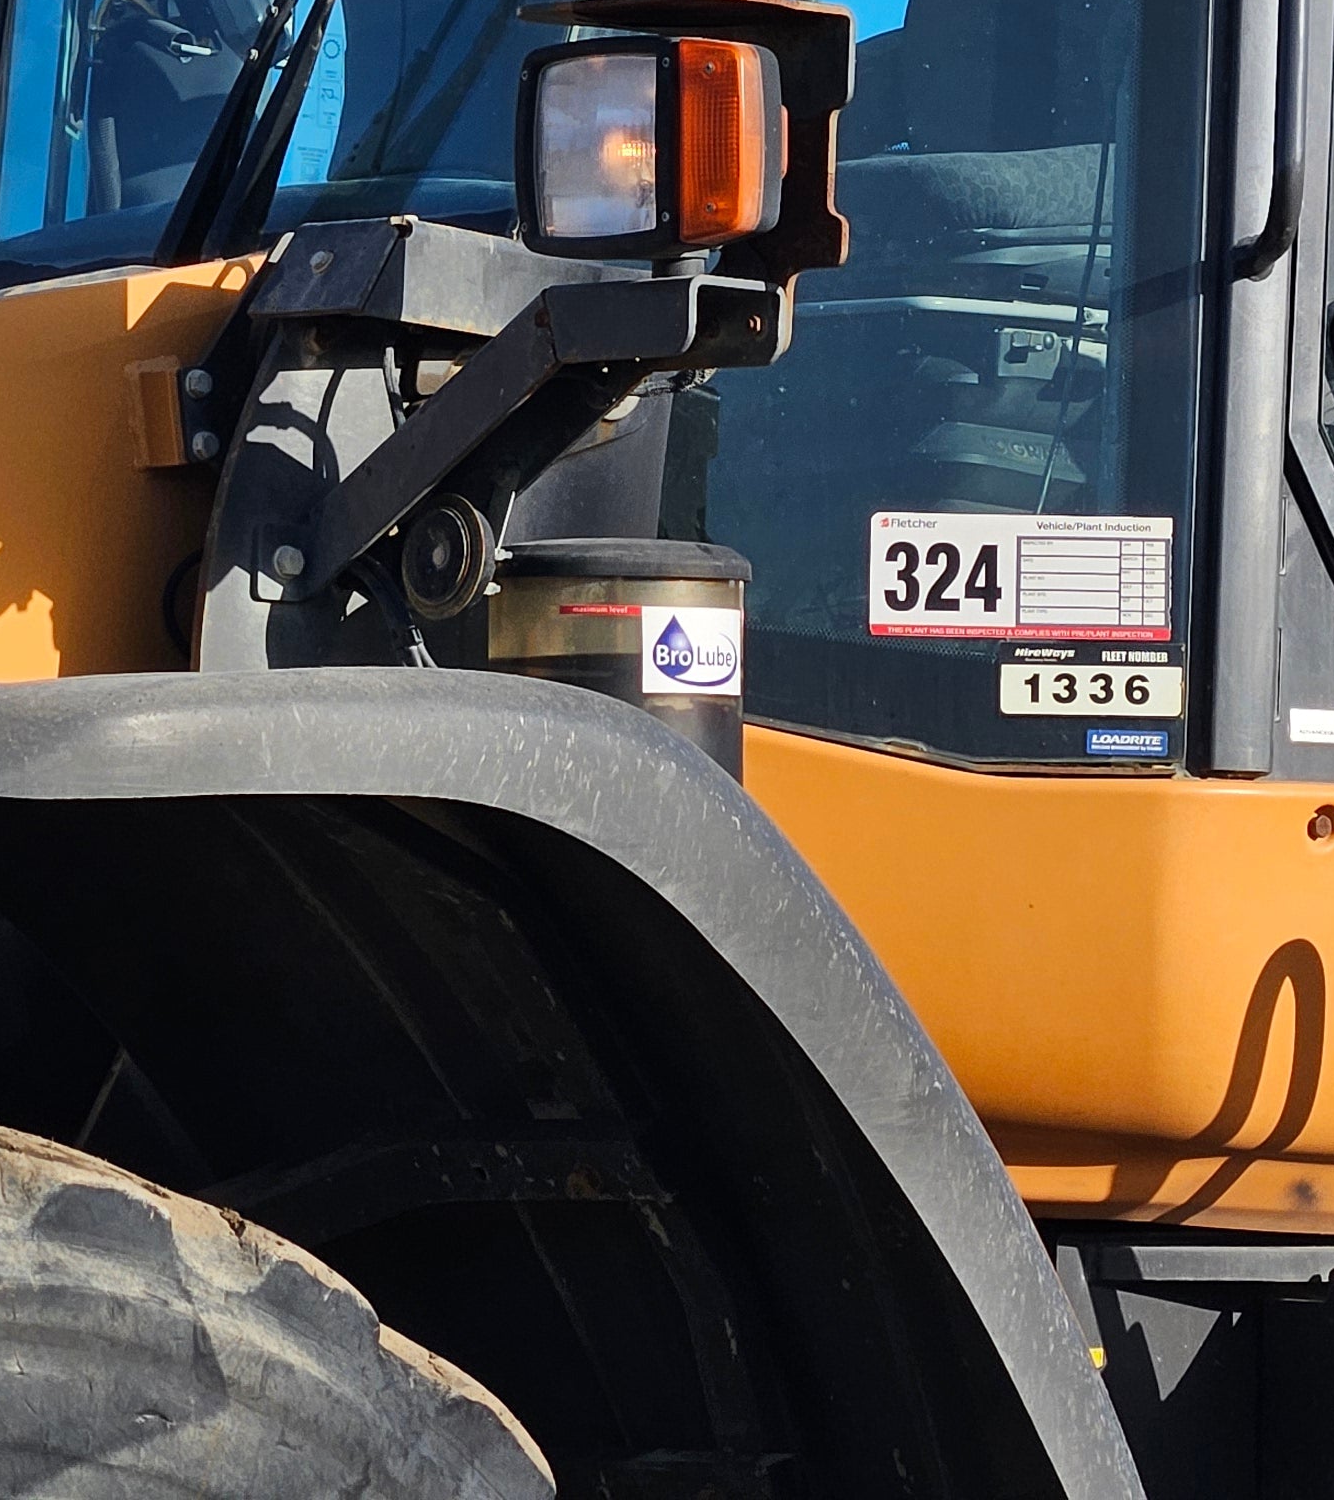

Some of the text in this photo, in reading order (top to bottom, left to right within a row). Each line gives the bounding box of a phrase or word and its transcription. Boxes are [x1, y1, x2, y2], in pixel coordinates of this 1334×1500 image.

[890, 517, 938, 529] Fletcher
[1036, 520, 1152, 533] Vehicle/Plant Induction
[883, 541, 1003, 613] 324
[609, 606, 628, 614] level
[887, 626, 904, 634] THIS
[905, 626, 928, 634] PLANT
[929, 627, 945, 635] HAS
[946, 627, 965, 635] BEEN
[966, 628, 1005, 636] INSPECTED
[1014, 629, 1051, 637] COMPLIES
[1111, 630, 1154, 639] INSPECTION
[1101, 650, 1168, 663] FLEET NUMBER
[1024, 672, 1150, 705] 1336
[1091, 734, 1163, 745] LOADRITE
